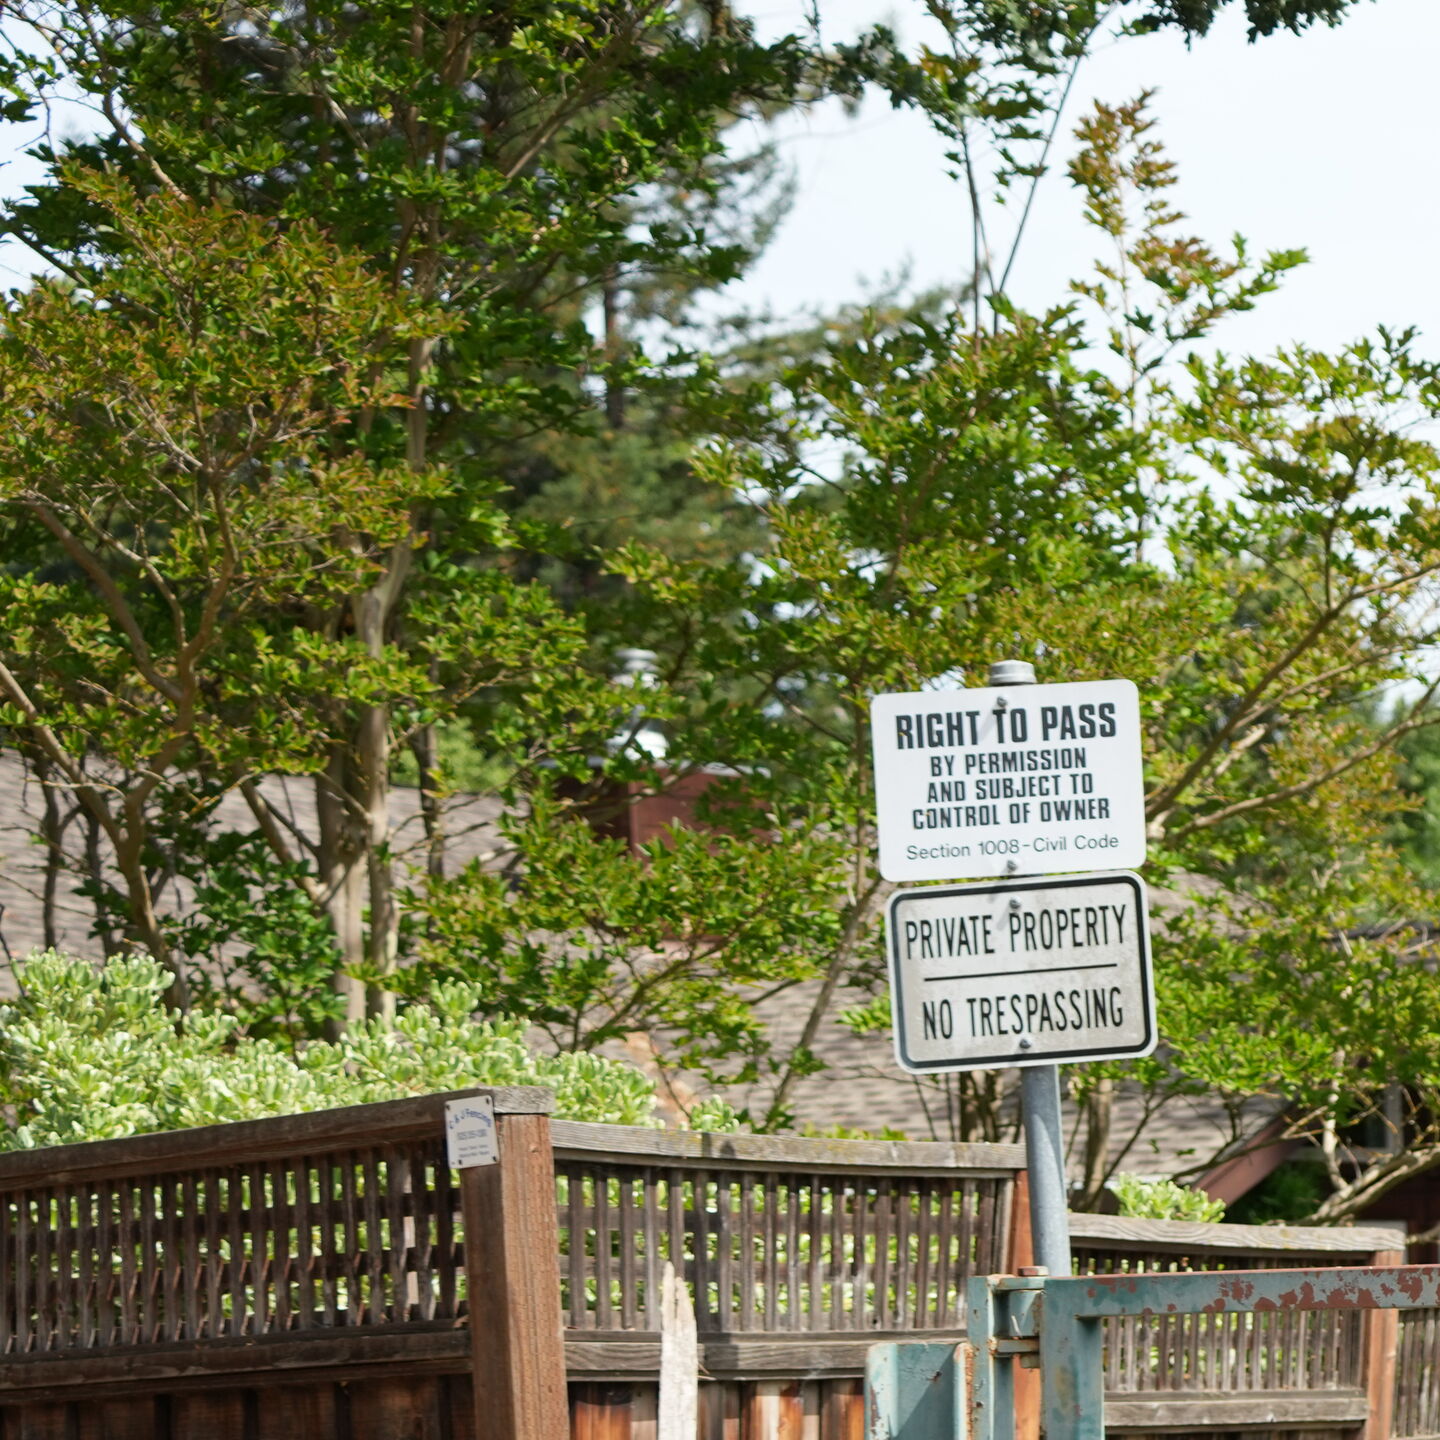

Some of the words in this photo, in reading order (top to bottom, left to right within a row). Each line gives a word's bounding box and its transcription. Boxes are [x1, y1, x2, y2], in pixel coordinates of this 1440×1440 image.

[895, 710, 980, 749] RIGHT
[992, 708, 1028, 744] TO
[1041, 703, 1116, 741] PASS
[931, 755, 955, 777] BY
[965, 747, 1086, 775] PERMISSION
[927, 780, 965, 803] AND
[976, 774, 1060, 800] SUBJECT
[1070, 773, 1094, 794] TO
[912, 804, 1000, 830] CONTROL
[1009, 803, 1030, 824] OF
[1040, 798, 1110, 822] OWNER
[906, 843, 971, 861] Section
[1074, 834, 1119, 850] Code
[905, 914, 995, 960] PRIVATE
[1009, 904, 1127, 953] PROPERTY
[922, 998, 953, 1041] NO
[967, 986, 1123, 1038] TRESPASSING
